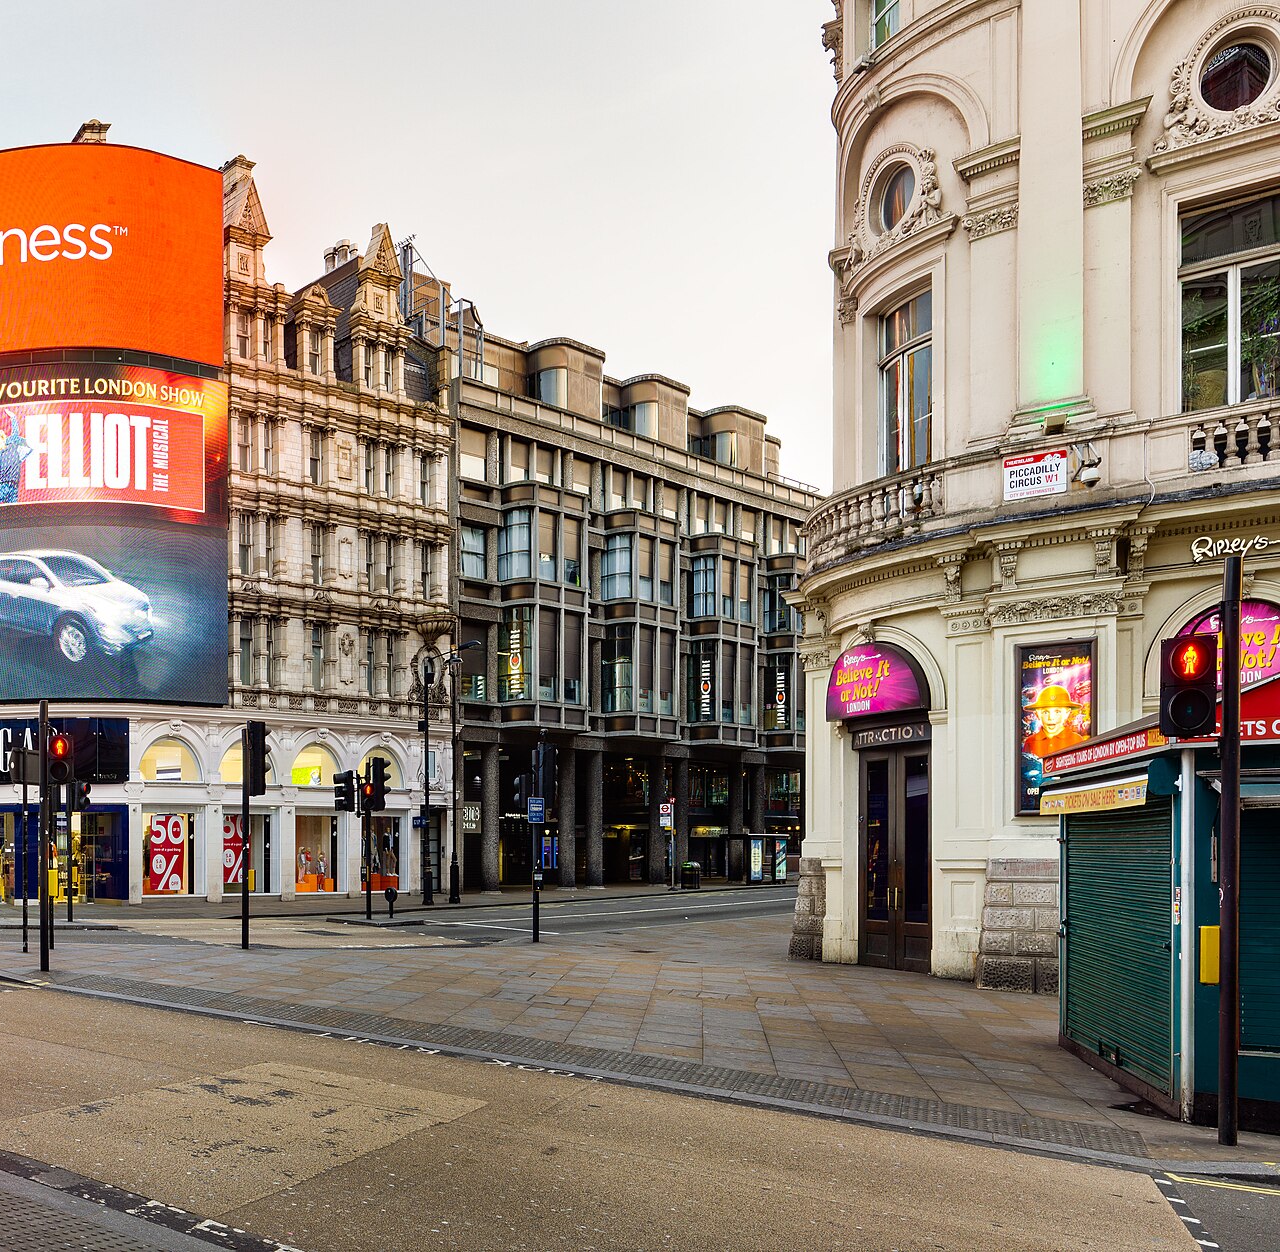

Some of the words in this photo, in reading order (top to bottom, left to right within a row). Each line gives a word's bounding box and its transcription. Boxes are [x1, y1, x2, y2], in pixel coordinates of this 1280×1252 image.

[84, 378, 157, 399] LONDON
[160, 385, 205, 408] SHOW
[25, 412, 151, 490] ELLIOT
[152, 419, 168, 470] MUSICAL
[1009, 462, 1061, 479] PICCADILLY
[152, 472, 168, 492] THE
[1009, 476, 1042, 489] CIRCUS
[1045, 474, 1058, 483] W1
[1022, 661, 1051, 669] Believe
[1052, 658, 1060, 666] It
[1071, 655, 1090, 665] Not!
[1042, 666, 1064, 674] LONDON
[836, 666, 873, 686] Believe
[876, 659, 890, 678] It
[841, 689, 851, 702] or
[852, 679, 880, 700] Not!
[846, 700, 871, 713] LONDON
[854, 725, 925, 745] ATTRACTION
[1055, 753, 1076, 768] SIGHTSEEING
[1076, 749, 1088, 762] TOURS
[1088, 748, 1093, 760] OF
[1093, 745, 1109, 759] LONDON
[1109, 743, 1115, 755] BY
[1115, 737, 1136, 753] OPEN-TOP
[1136, 733, 1146, 748] BUS
[1065, 795, 1082, 809] TICKETS
[1082, 793, 1090, 807] ON
[1090, 791, 1102, 806] SALE
[1101, 789, 1116, 805] HERE
[151, 815, 184, 845] 50
